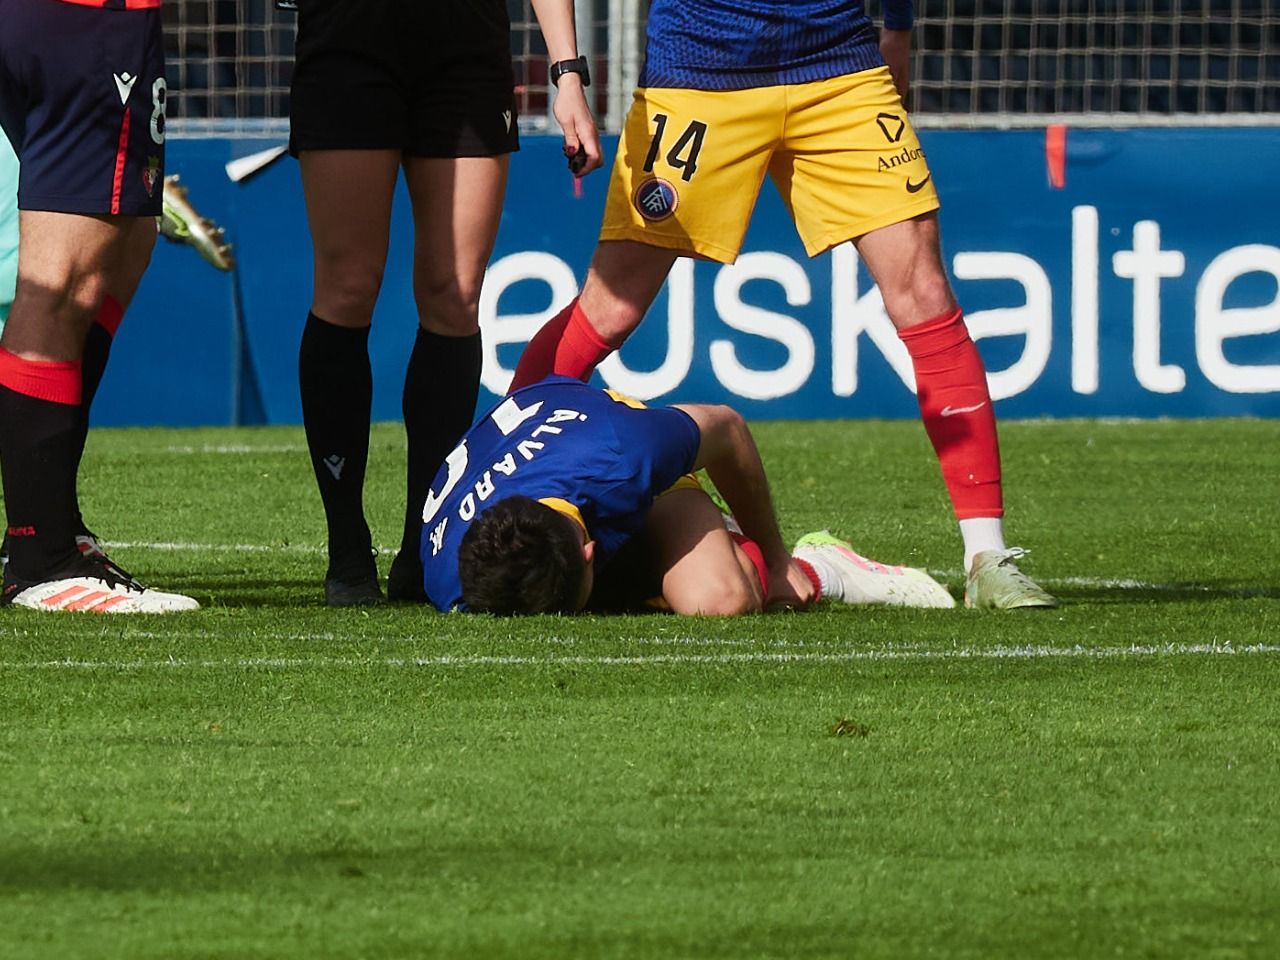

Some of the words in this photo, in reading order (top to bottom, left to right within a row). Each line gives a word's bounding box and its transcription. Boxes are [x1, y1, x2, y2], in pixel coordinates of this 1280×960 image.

[150, 77, 167, 145] 8
[642, 113, 708, 182] 14
[458, 409, 588, 522] ÁLVARO
